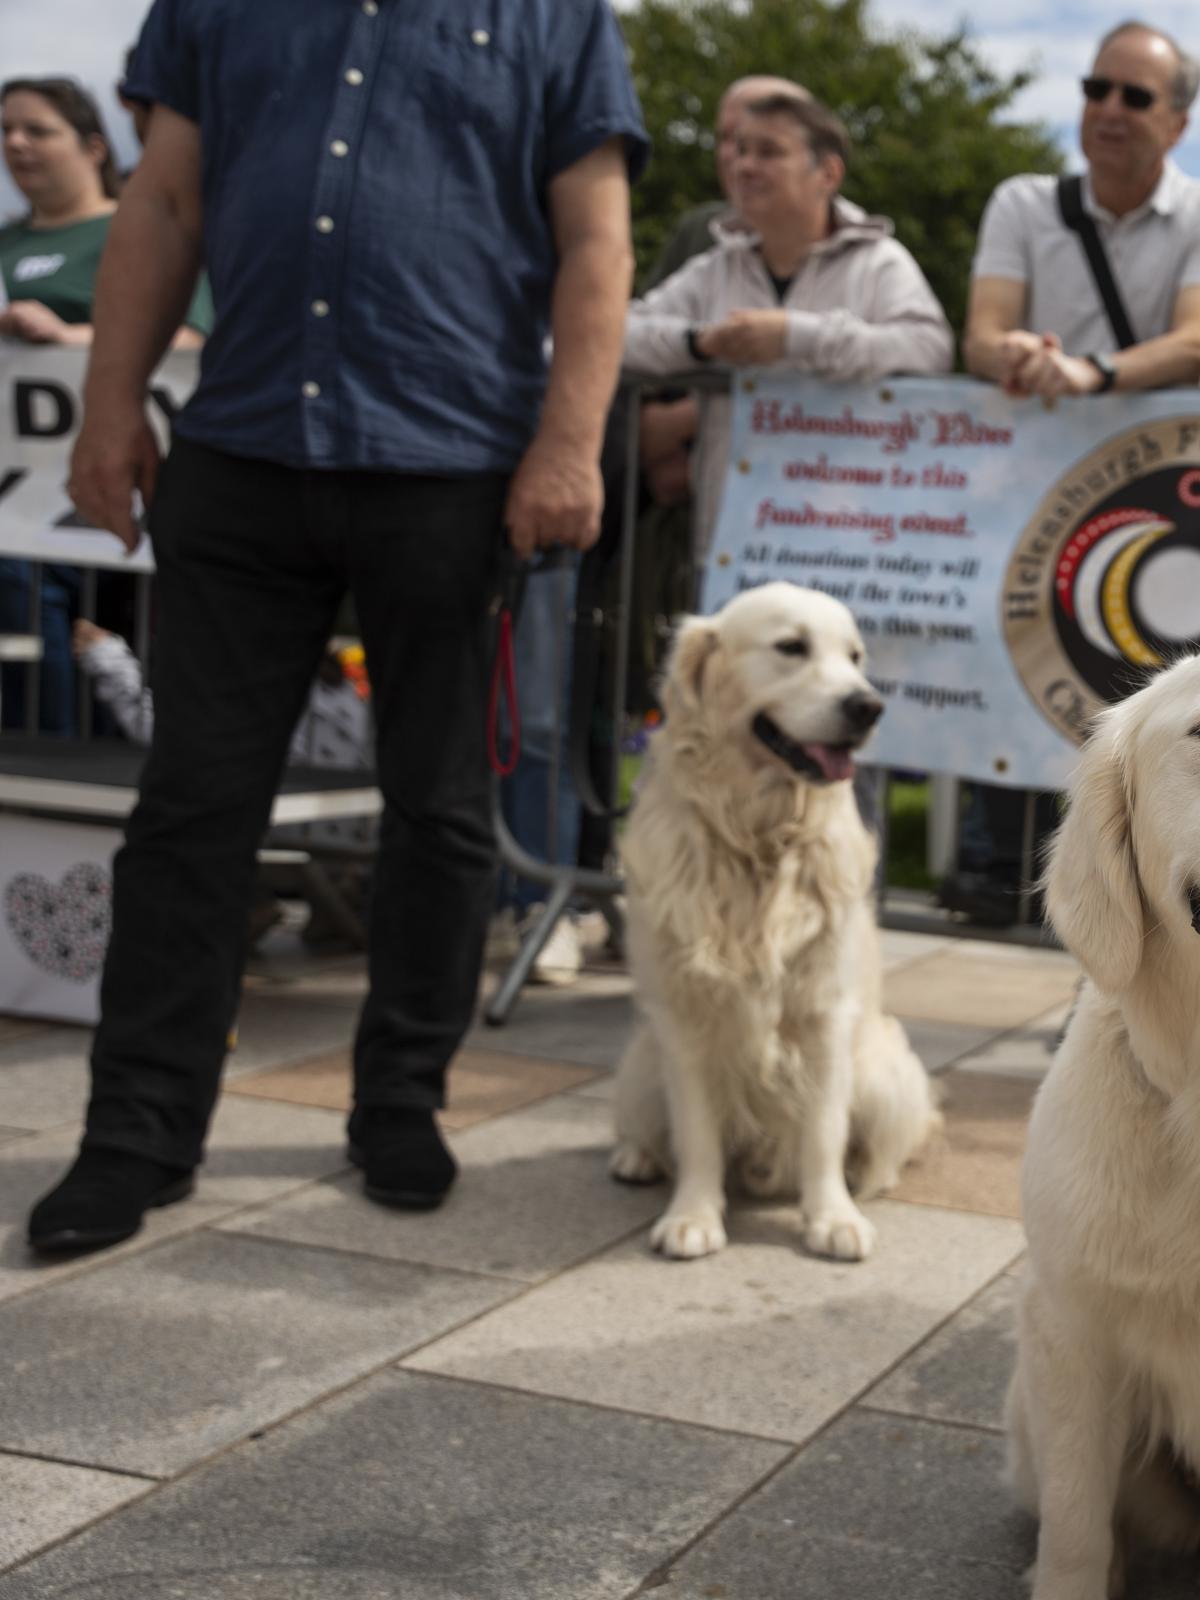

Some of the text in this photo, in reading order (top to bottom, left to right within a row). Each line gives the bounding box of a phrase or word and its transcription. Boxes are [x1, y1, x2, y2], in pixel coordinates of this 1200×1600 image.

[783, 453, 968, 489] welcome to this
[755, 498, 896, 543] fundraising
[1008, 433, 1162, 620] Helensburgh
[776, 548, 869, 571] donations
[875, 552, 934, 579] today
[940, 558, 981, 579] will
[860, 580, 892, 603] the
[899, 586, 968, 609] town's
[881, 615, 923, 635] this
